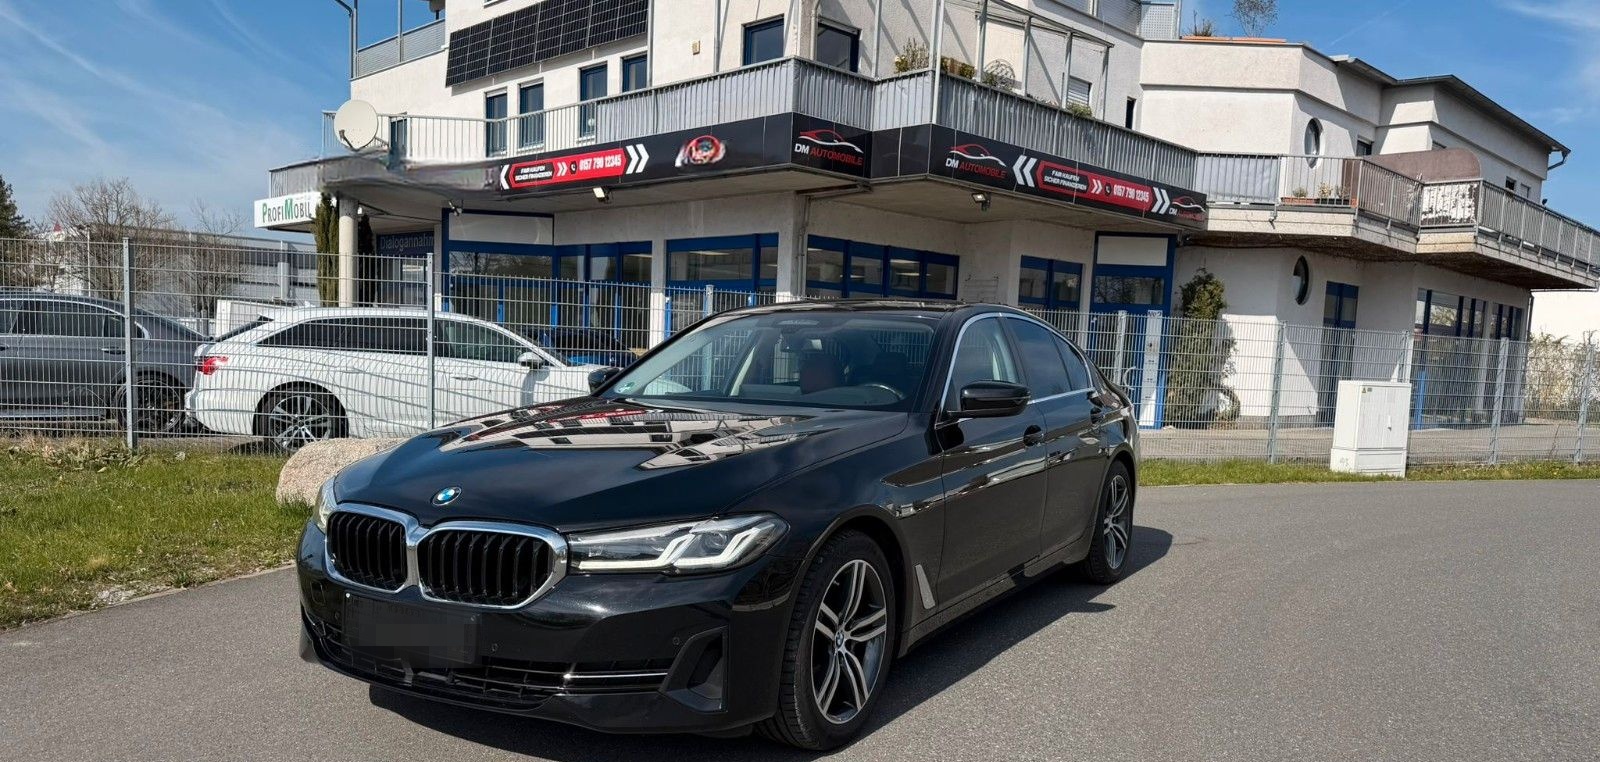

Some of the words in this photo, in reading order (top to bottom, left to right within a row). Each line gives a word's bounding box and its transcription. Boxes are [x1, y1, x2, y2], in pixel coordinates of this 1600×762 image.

[794, 143, 810, 155] DM
[810, 147, 863, 166] AUTOMOBILE
[945, 158, 960, 169] DM
[960, 161, 1008, 179] AUTOMOBILE
